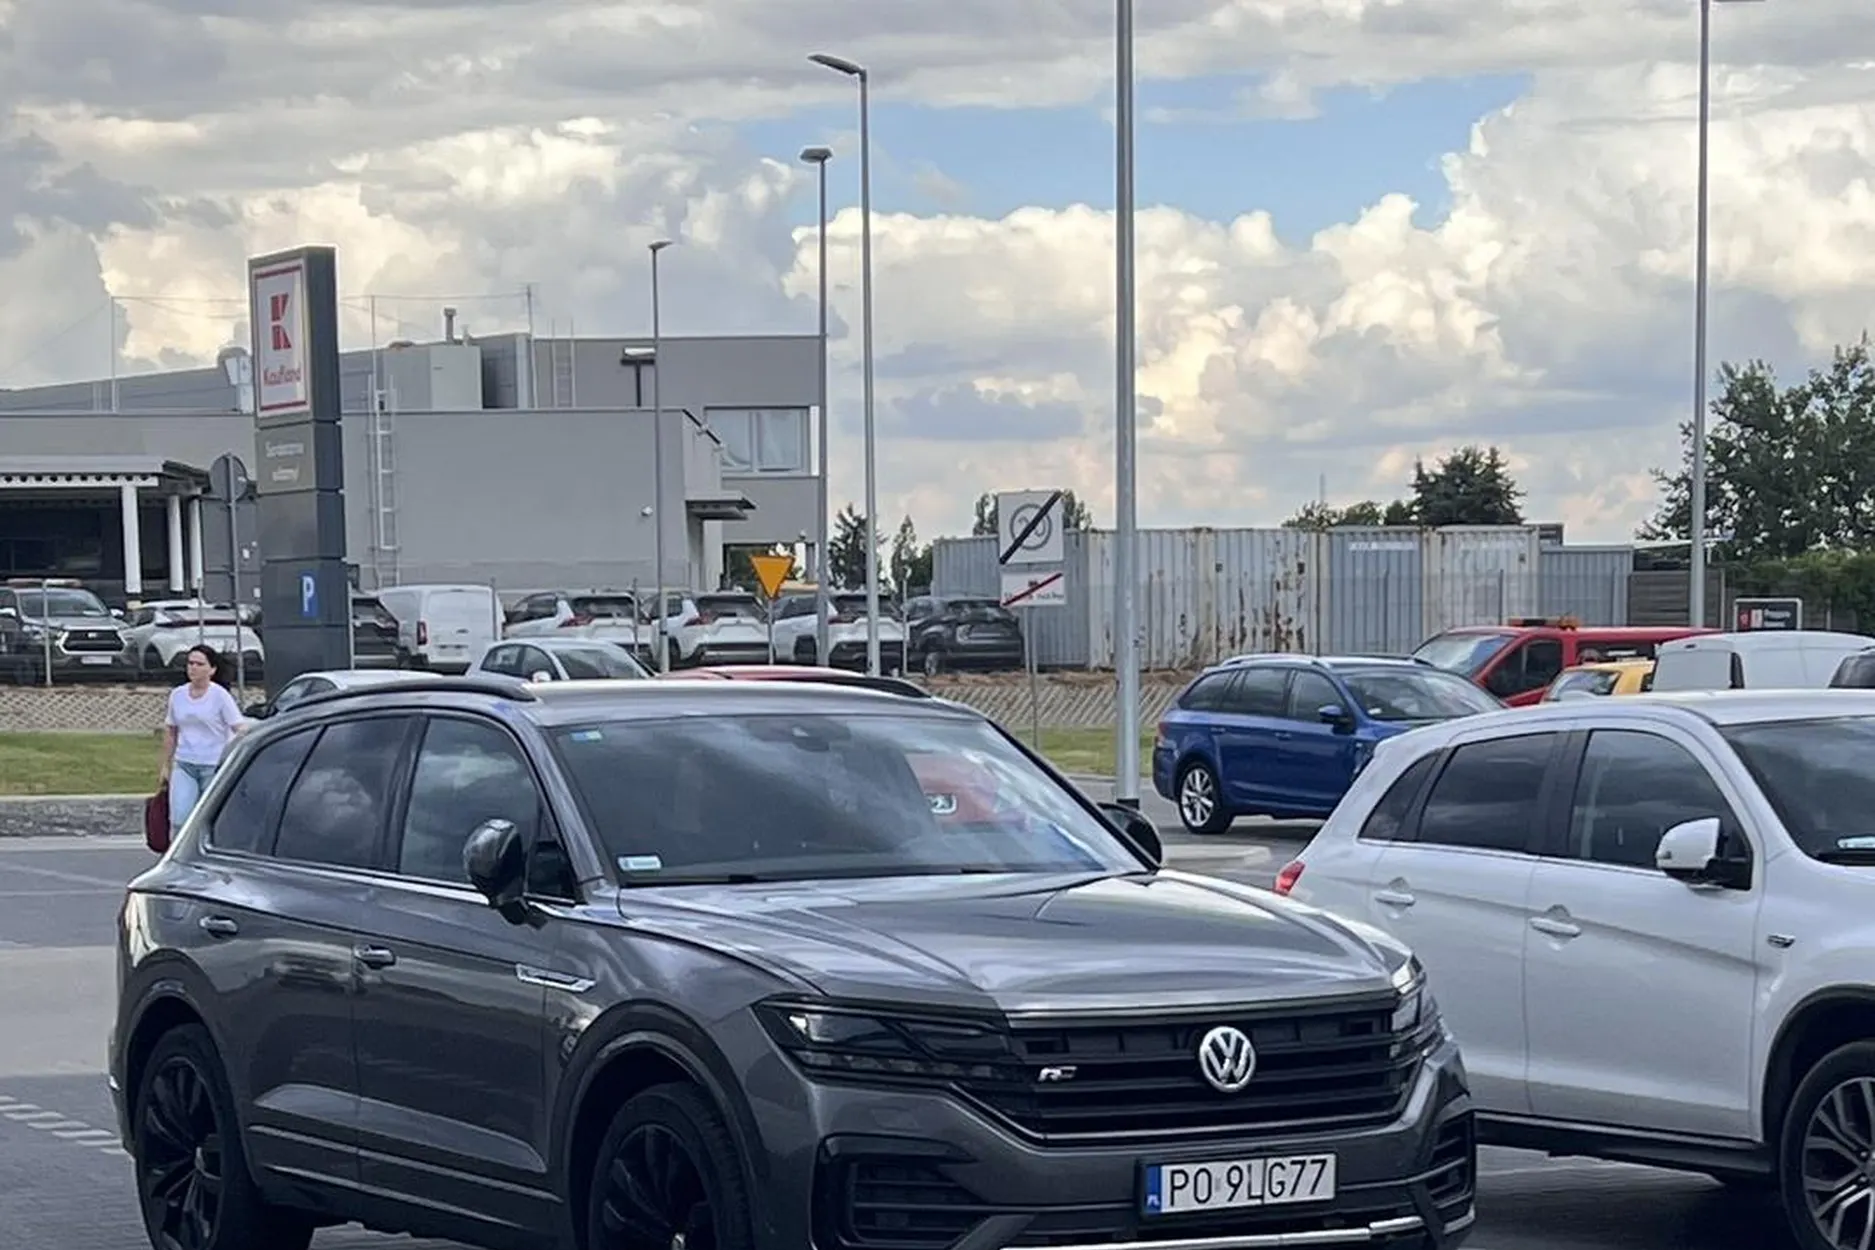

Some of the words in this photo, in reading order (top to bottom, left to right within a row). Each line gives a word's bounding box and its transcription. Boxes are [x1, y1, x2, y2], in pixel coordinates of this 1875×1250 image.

[302, 575, 315, 612] P
[1170, 1167, 1213, 1208] PO
[1227, 1158, 1328, 1203] 9LG77
